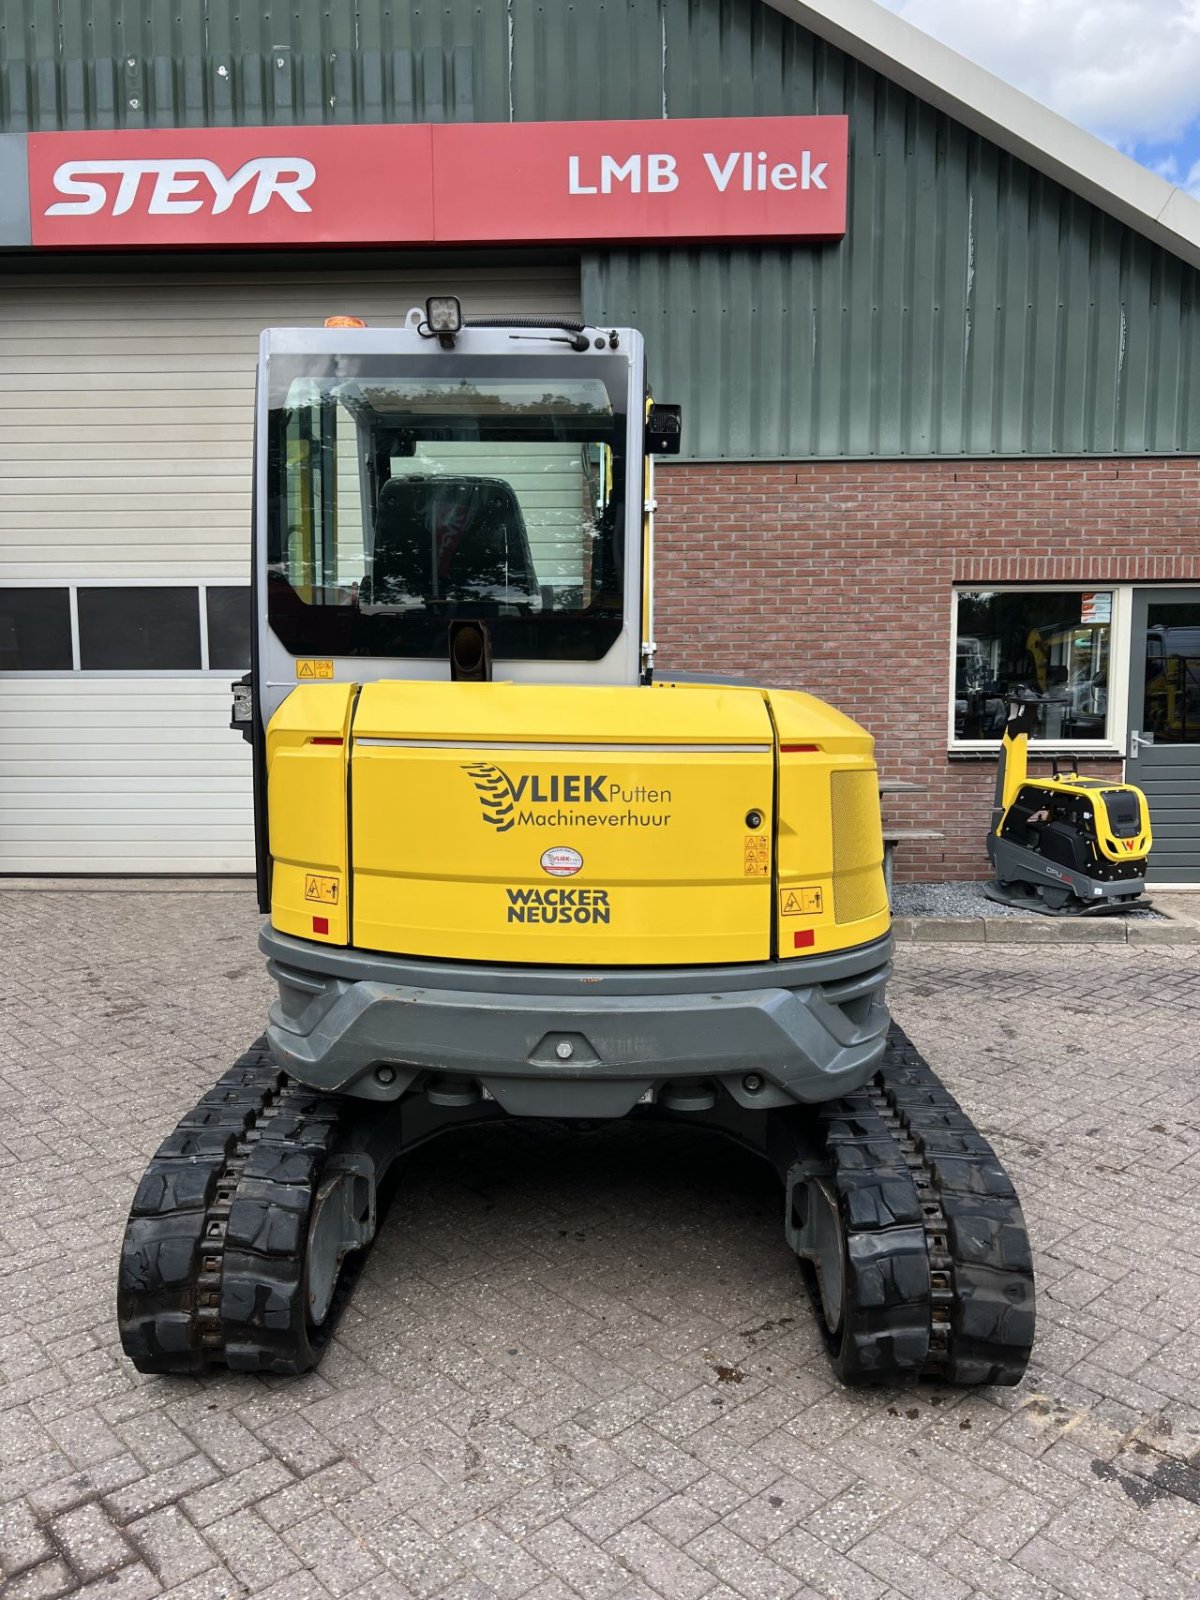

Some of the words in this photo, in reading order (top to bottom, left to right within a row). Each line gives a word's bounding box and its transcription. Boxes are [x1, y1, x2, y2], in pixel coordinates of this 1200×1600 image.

[568, 153, 680, 196] LMB
[702, 150, 829, 193] Vliek
[44, 157, 317, 217] STEYR
[507, 775, 609, 803] VLIEK
[610, 784, 672, 803] Putten
[517, 808, 672, 827] Machineverhuur
[506, 888, 610, 907] WACKER
[506, 906, 610, 924] NEUSON
